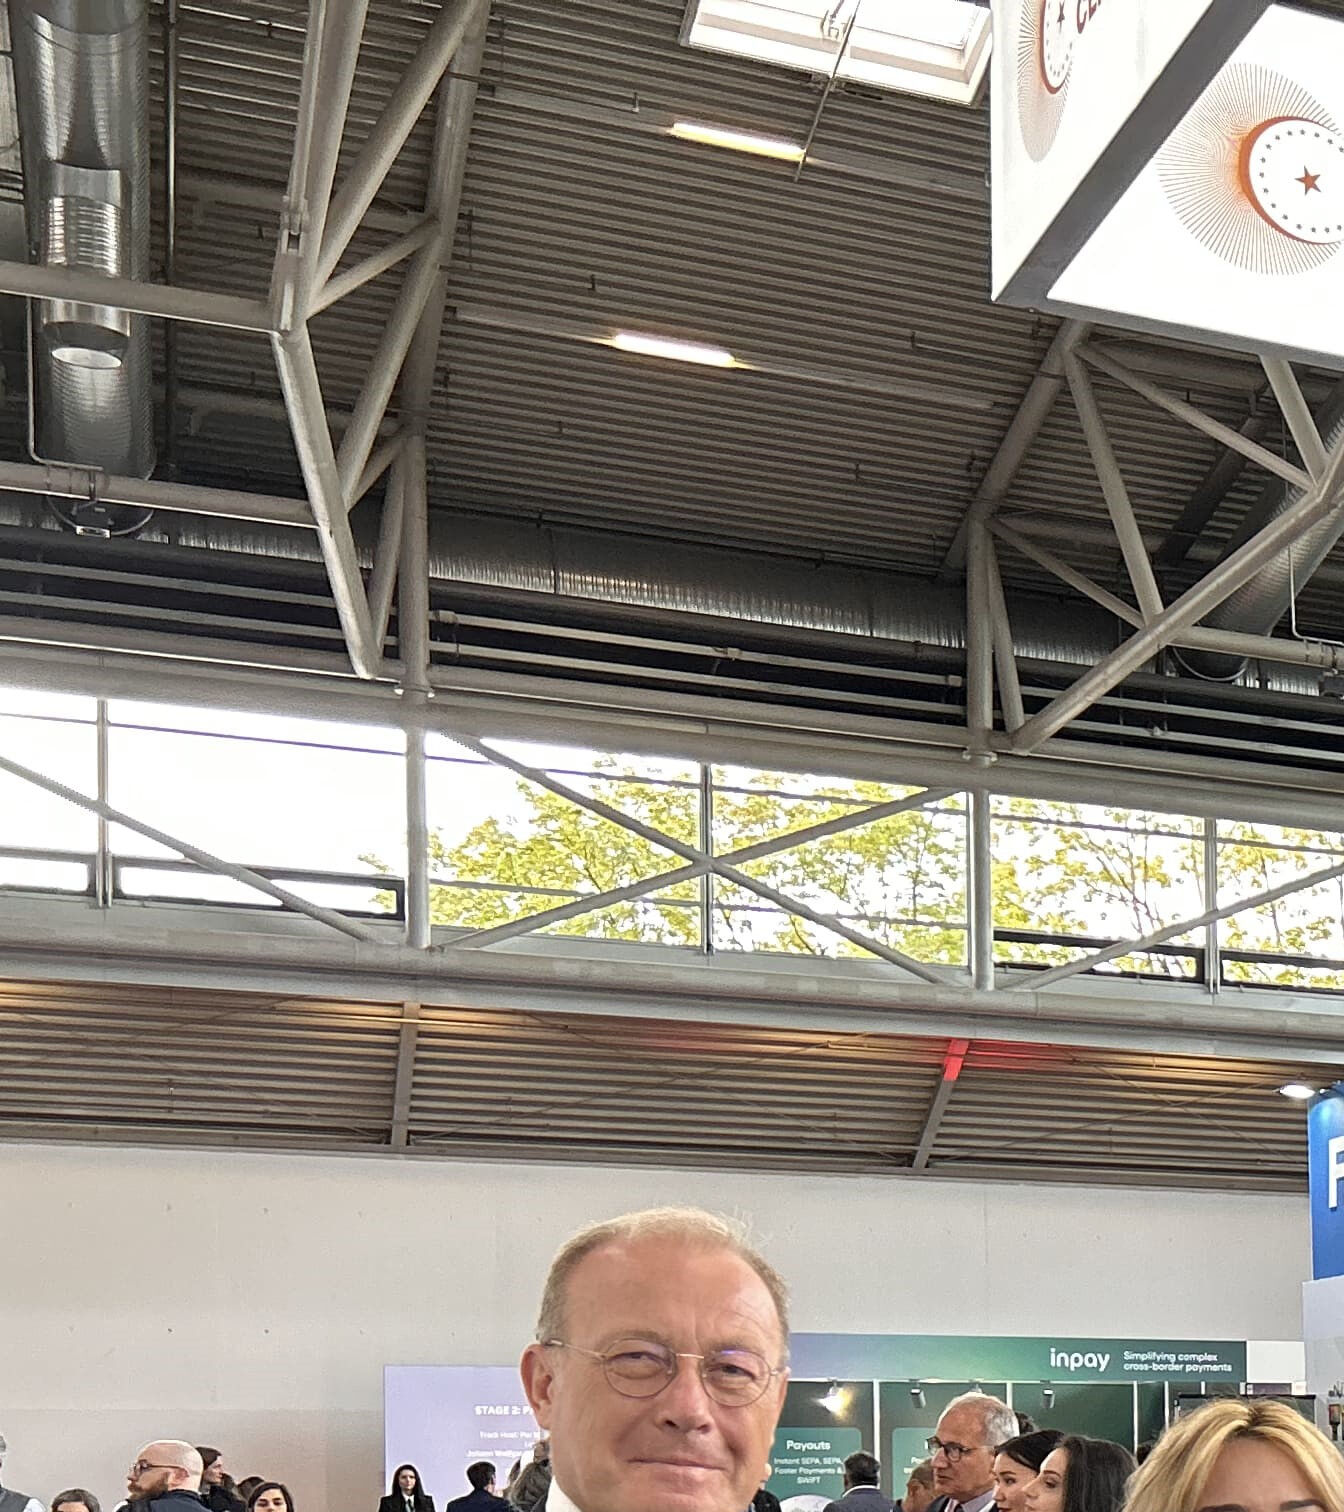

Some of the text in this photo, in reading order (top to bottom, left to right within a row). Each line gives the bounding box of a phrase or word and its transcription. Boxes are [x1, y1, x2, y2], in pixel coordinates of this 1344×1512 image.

[1050, 1348, 1218, 1371] inpay Simplifying complex
[1186, 1363, 1232, 1373] payments
[787, 1440, 831, 1452] Payouts
